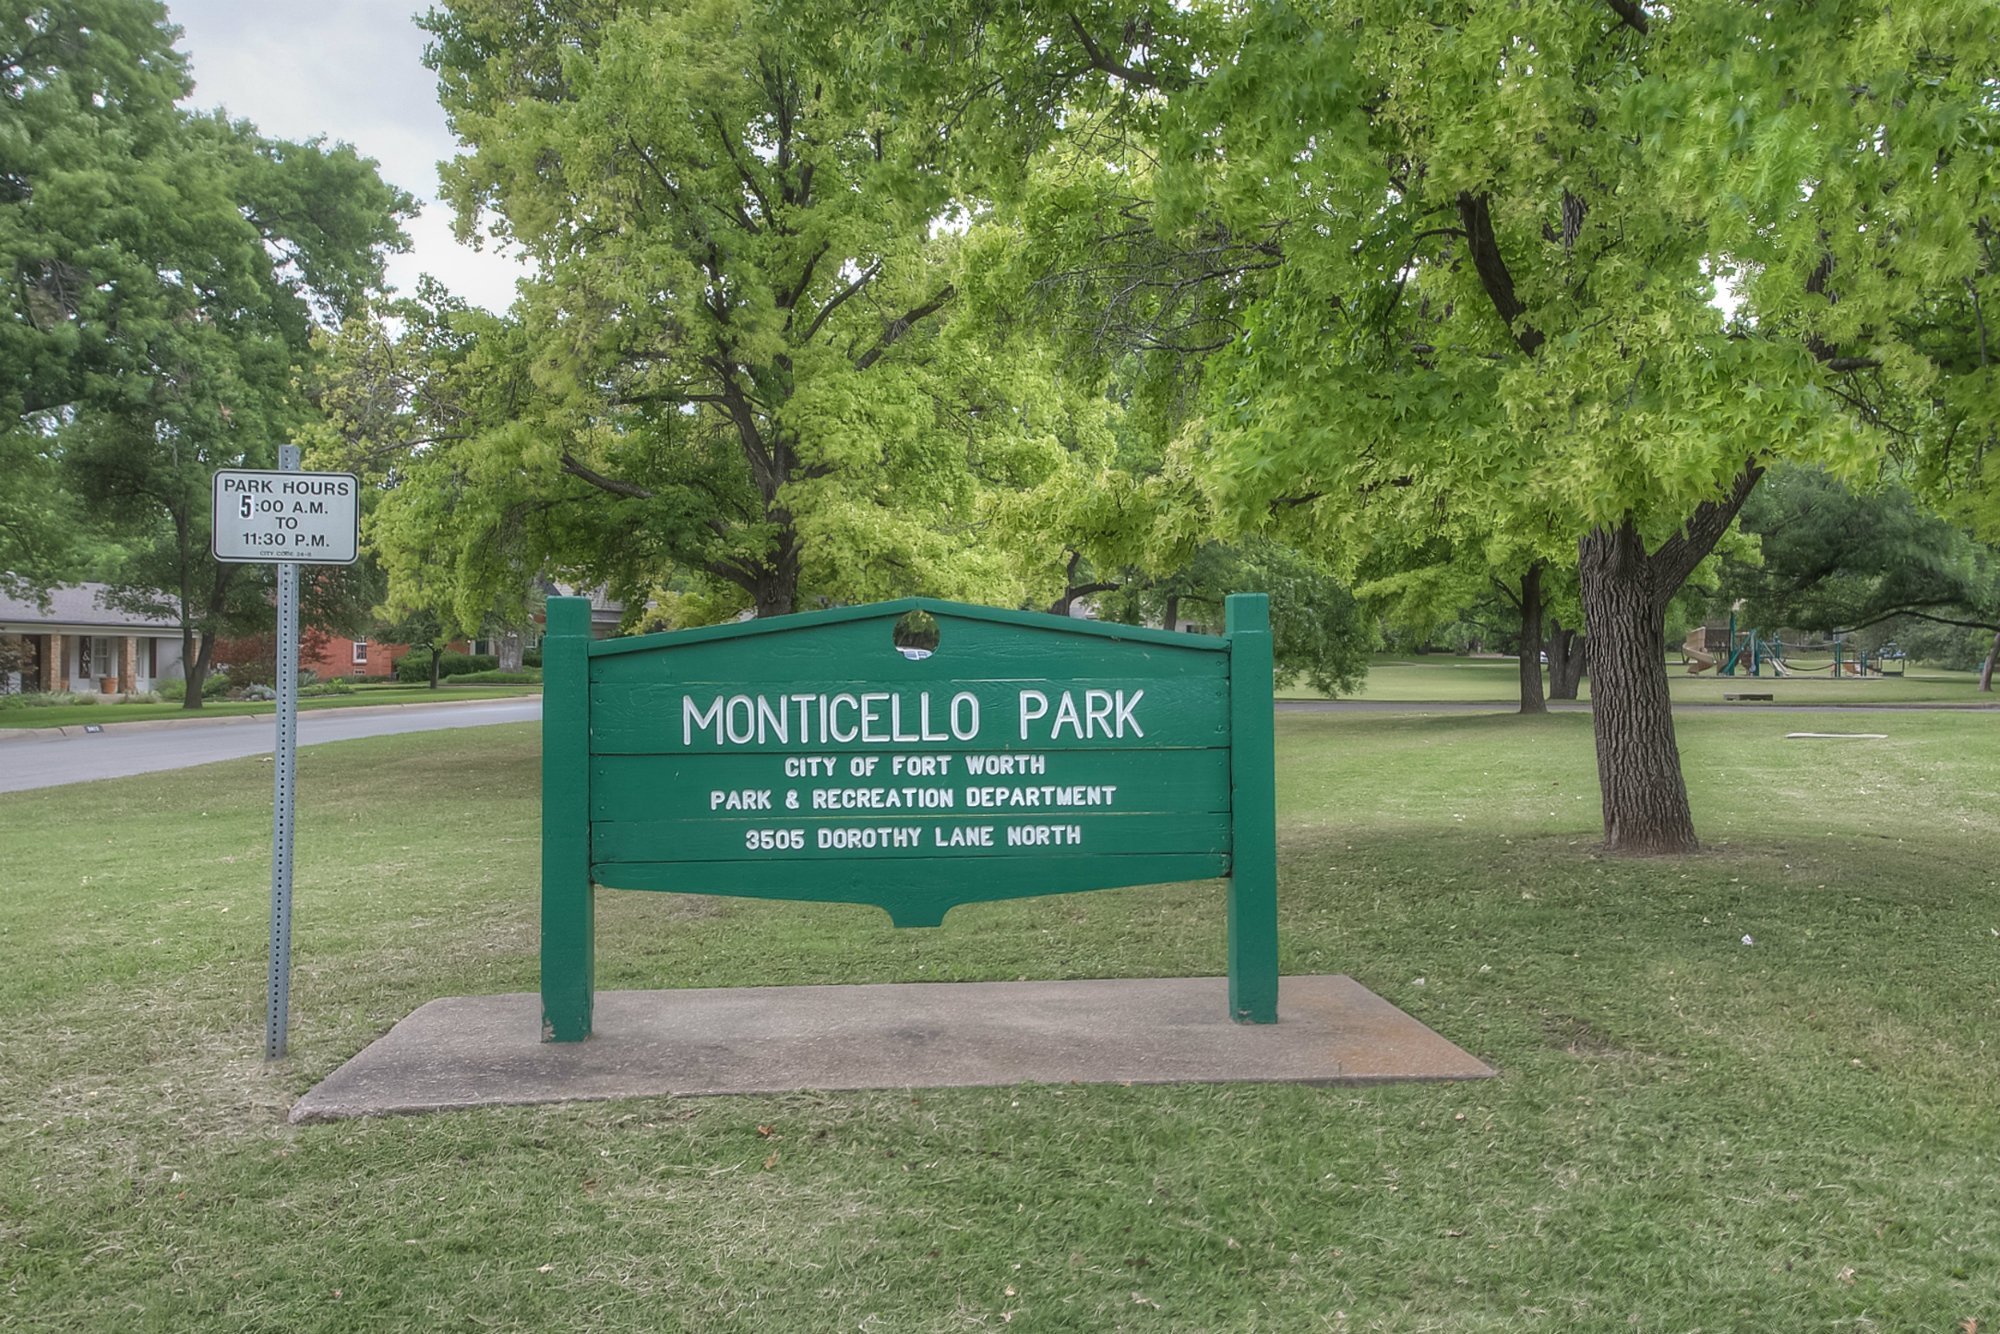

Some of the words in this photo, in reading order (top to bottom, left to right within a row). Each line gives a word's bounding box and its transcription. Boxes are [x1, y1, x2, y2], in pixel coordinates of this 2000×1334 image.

[224, 478, 274, 494] PARK
[282, 480, 349, 496] HOURS
[240, 494, 285, 519] 5:00
[292, 500, 329, 515] A.M.
[275, 516, 298, 530] TO
[242, 532, 286, 546] 11:30
[294, 533, 330, 548] P.M.
[682, 691, 980, 746] MONTICELLO
[1019, 689, 1145, 741] PARK
[784, 756, 837, 778] CITY
[850, 756, 879, 777] OF
[892, 754, 952, 777] FORT
[965, 754, 1045, 776] WORTH
[710, 789, 772, 811] PARK
[785, 789, 800, 810] &
[812, 787, 954, 810] RECREATION
[965, 785, 1117, 807] DEPARTMENT
[745, 829, 805, 850] 3505
[817, 826, 922, 849] DOROTHY
[934, 825, 994, 847] LANE
[1007, 824, 1081, 847] NORTH
